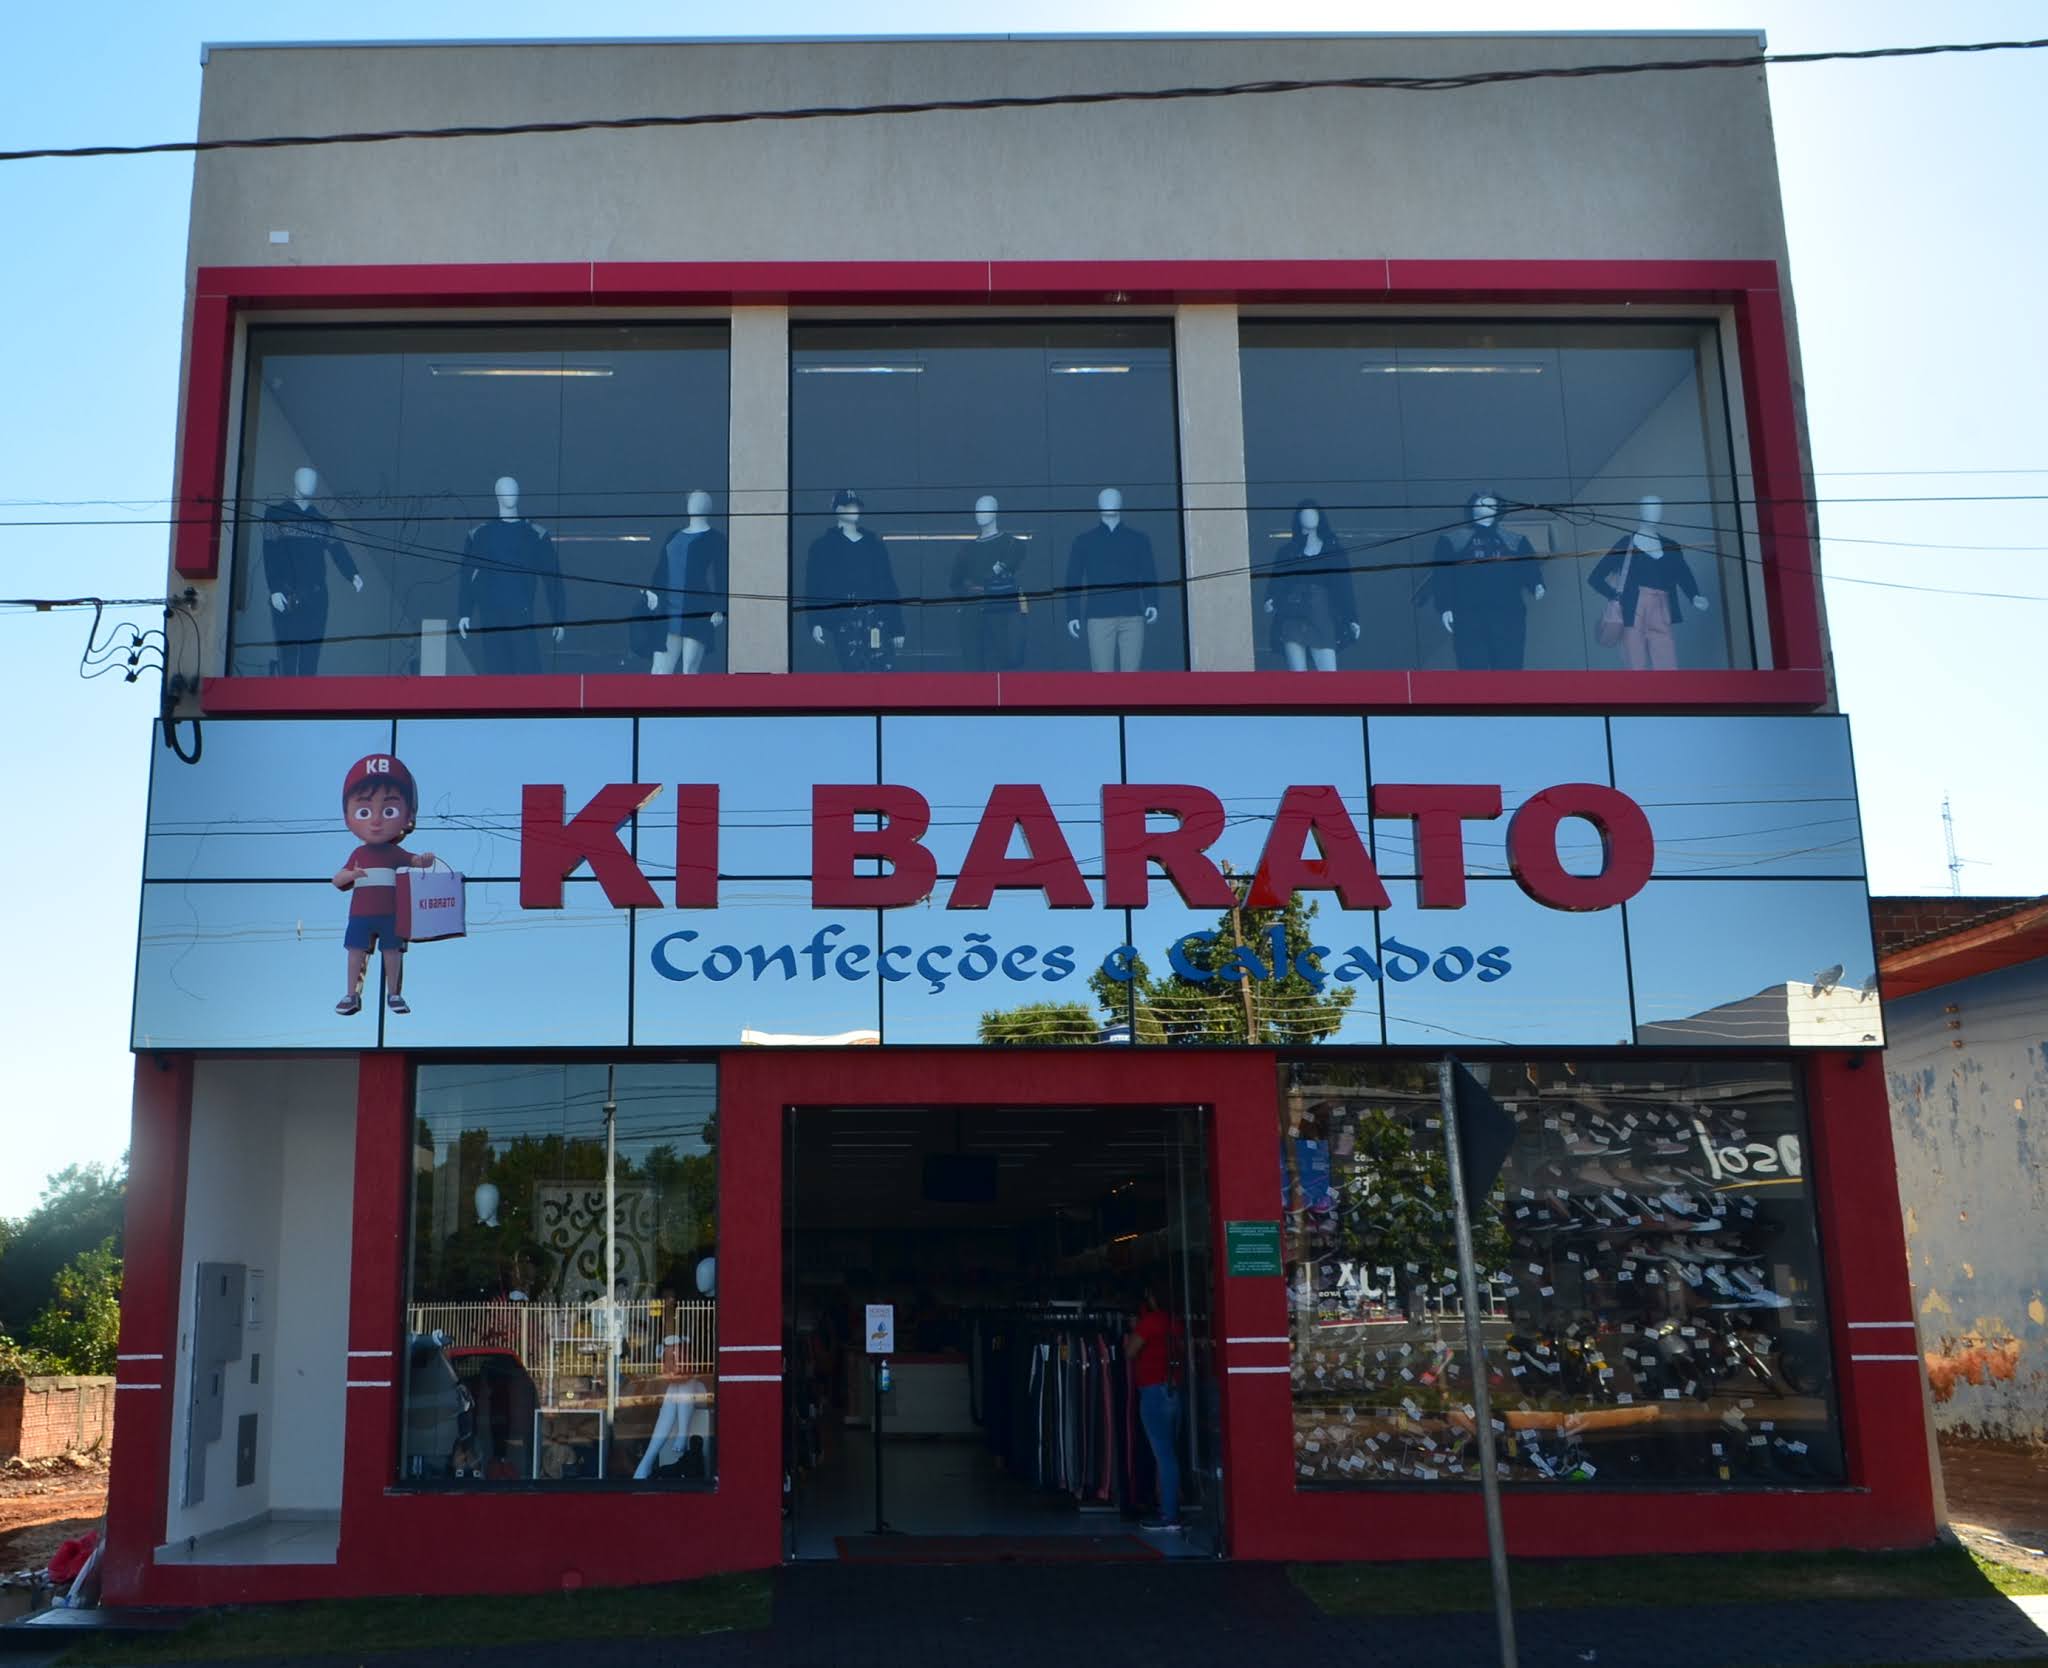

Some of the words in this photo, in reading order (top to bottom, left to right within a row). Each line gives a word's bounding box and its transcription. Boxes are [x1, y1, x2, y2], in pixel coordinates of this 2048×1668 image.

[366, 759, 389, 774] KB
[521, 783, 719, 909] KI
[812, 783, 1654, 910] BARATO
[650, 923, 1076, 994] Confecções
[1102, 945, 1138, 981] e
[1169, 925, 1512, 994] Calçados
